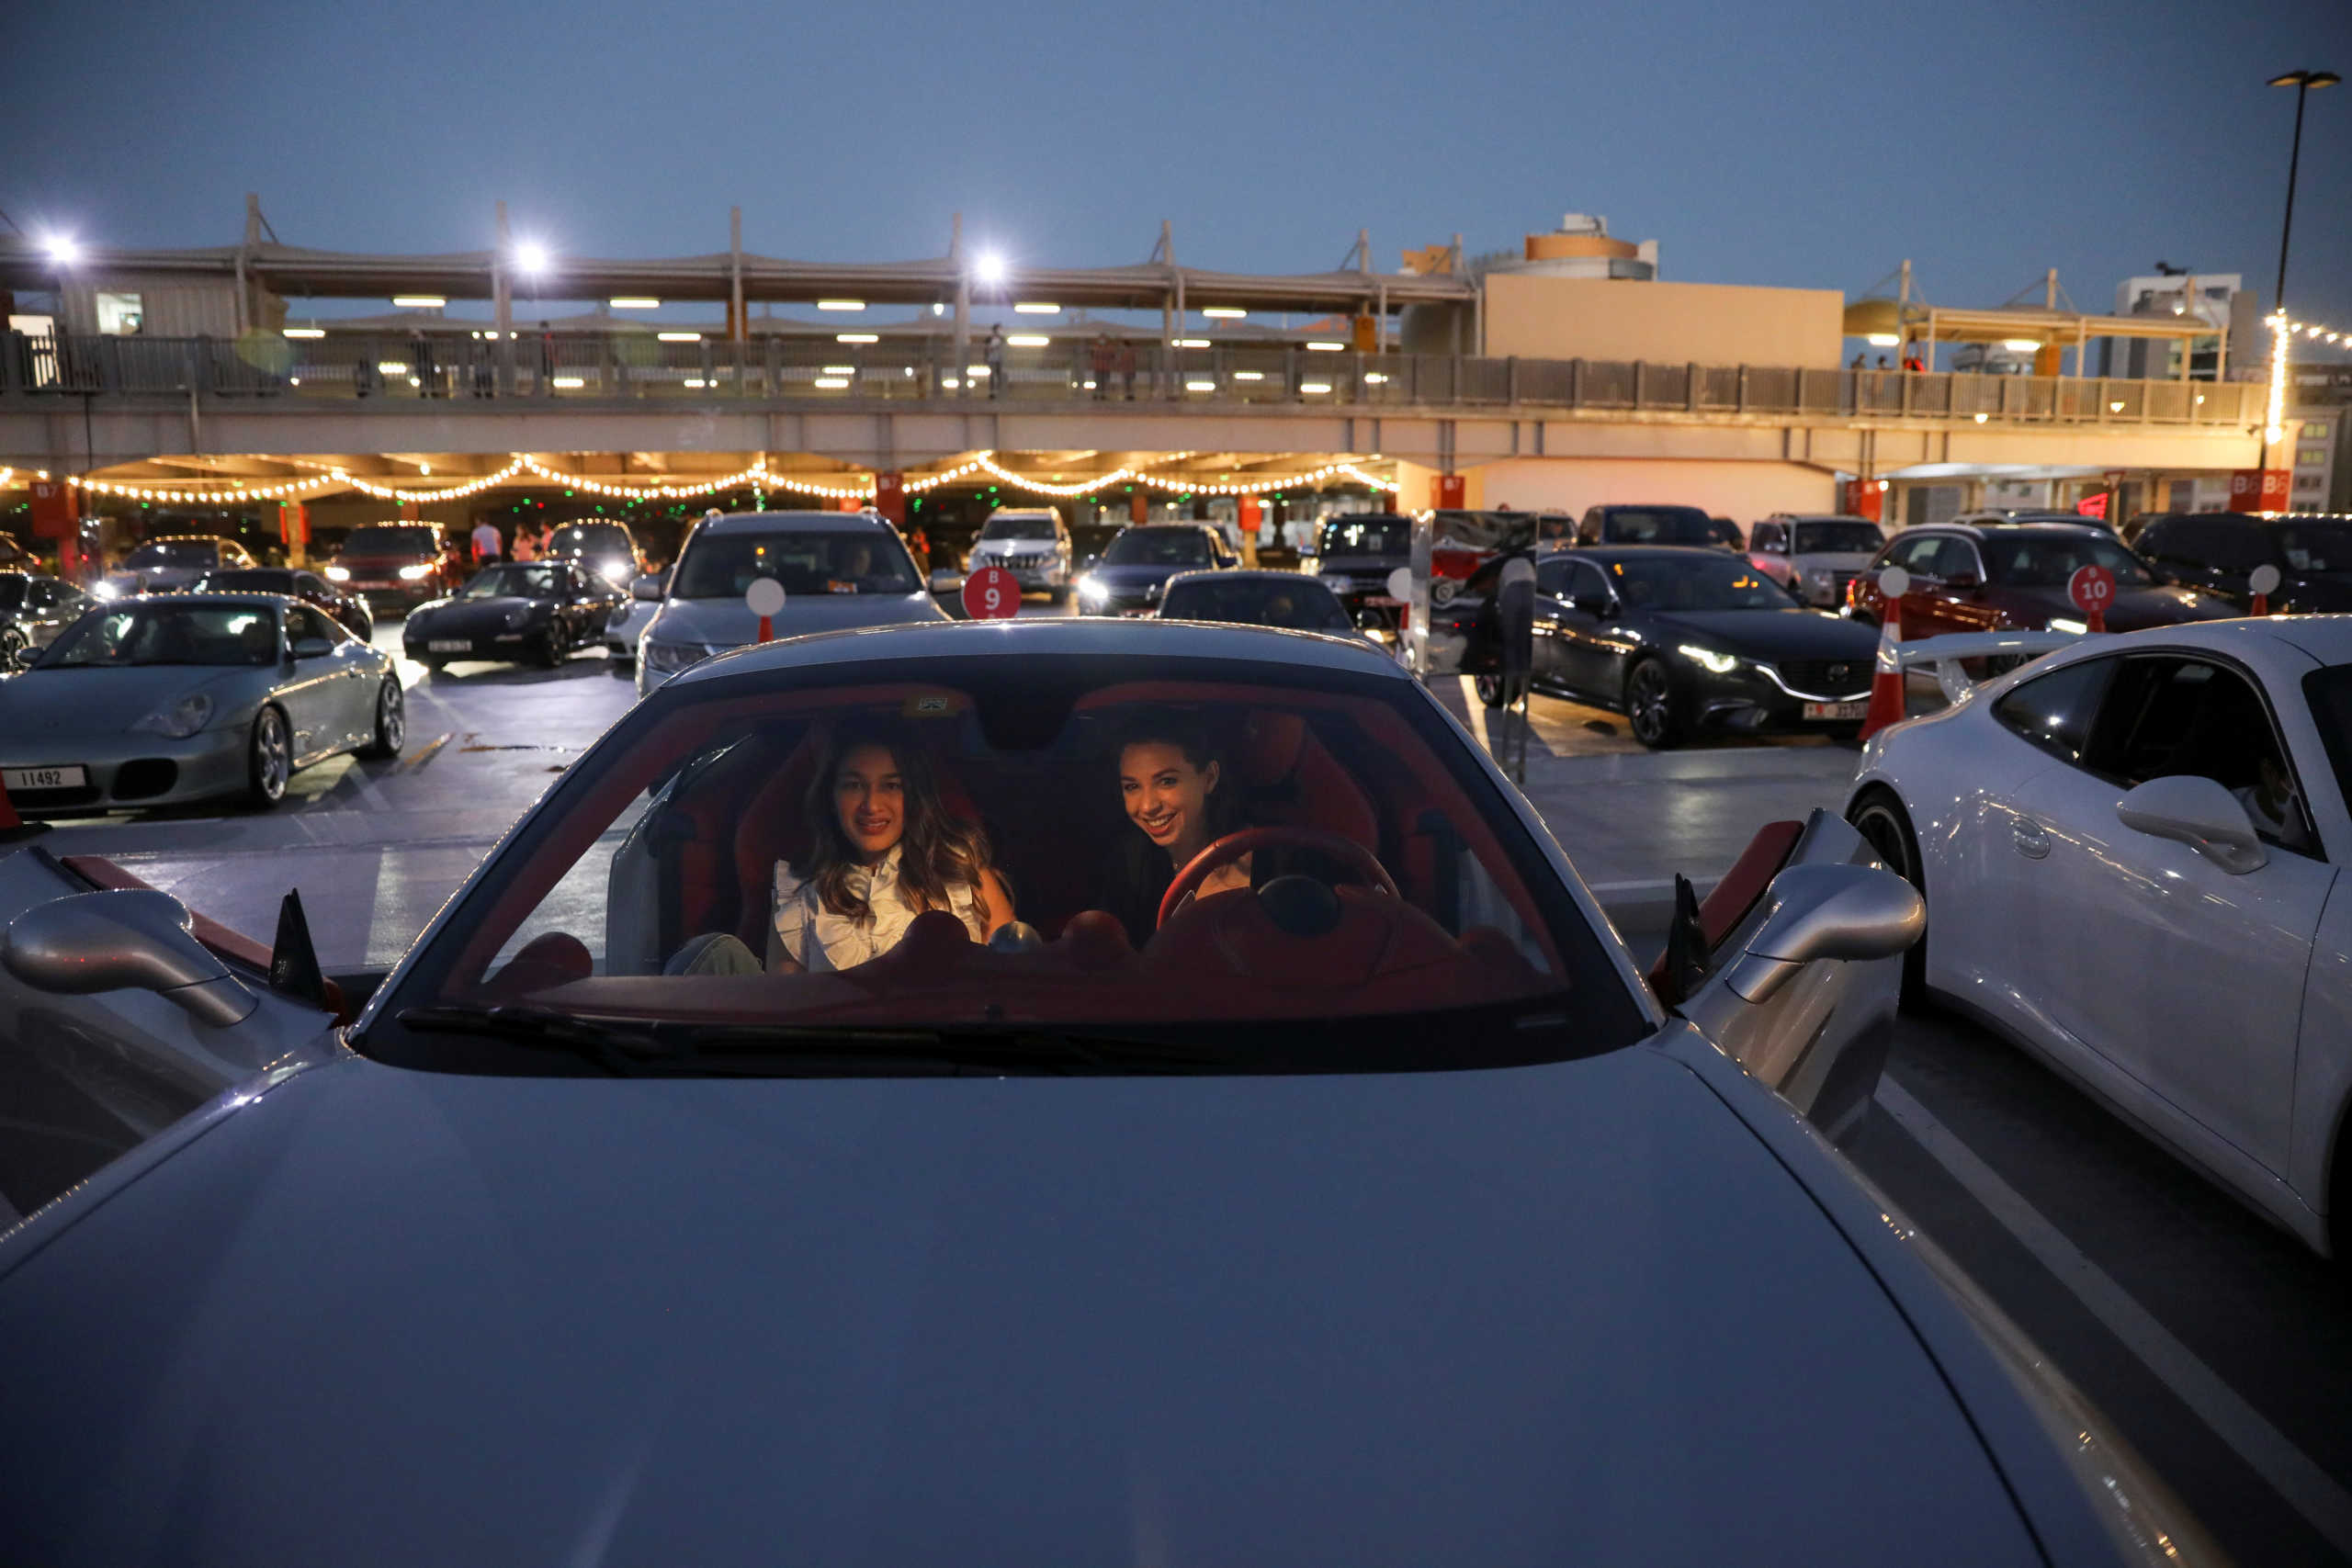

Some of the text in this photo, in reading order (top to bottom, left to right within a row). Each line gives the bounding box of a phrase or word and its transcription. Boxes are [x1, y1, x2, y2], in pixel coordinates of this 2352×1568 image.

[2263, 475, 2287, 494] B6
[989, 570, 999, 584] B
[985, 588, 1000, 610] 9
[2082, 581, 2108, 600] 10
[21, 771, 62, 787] 11492
